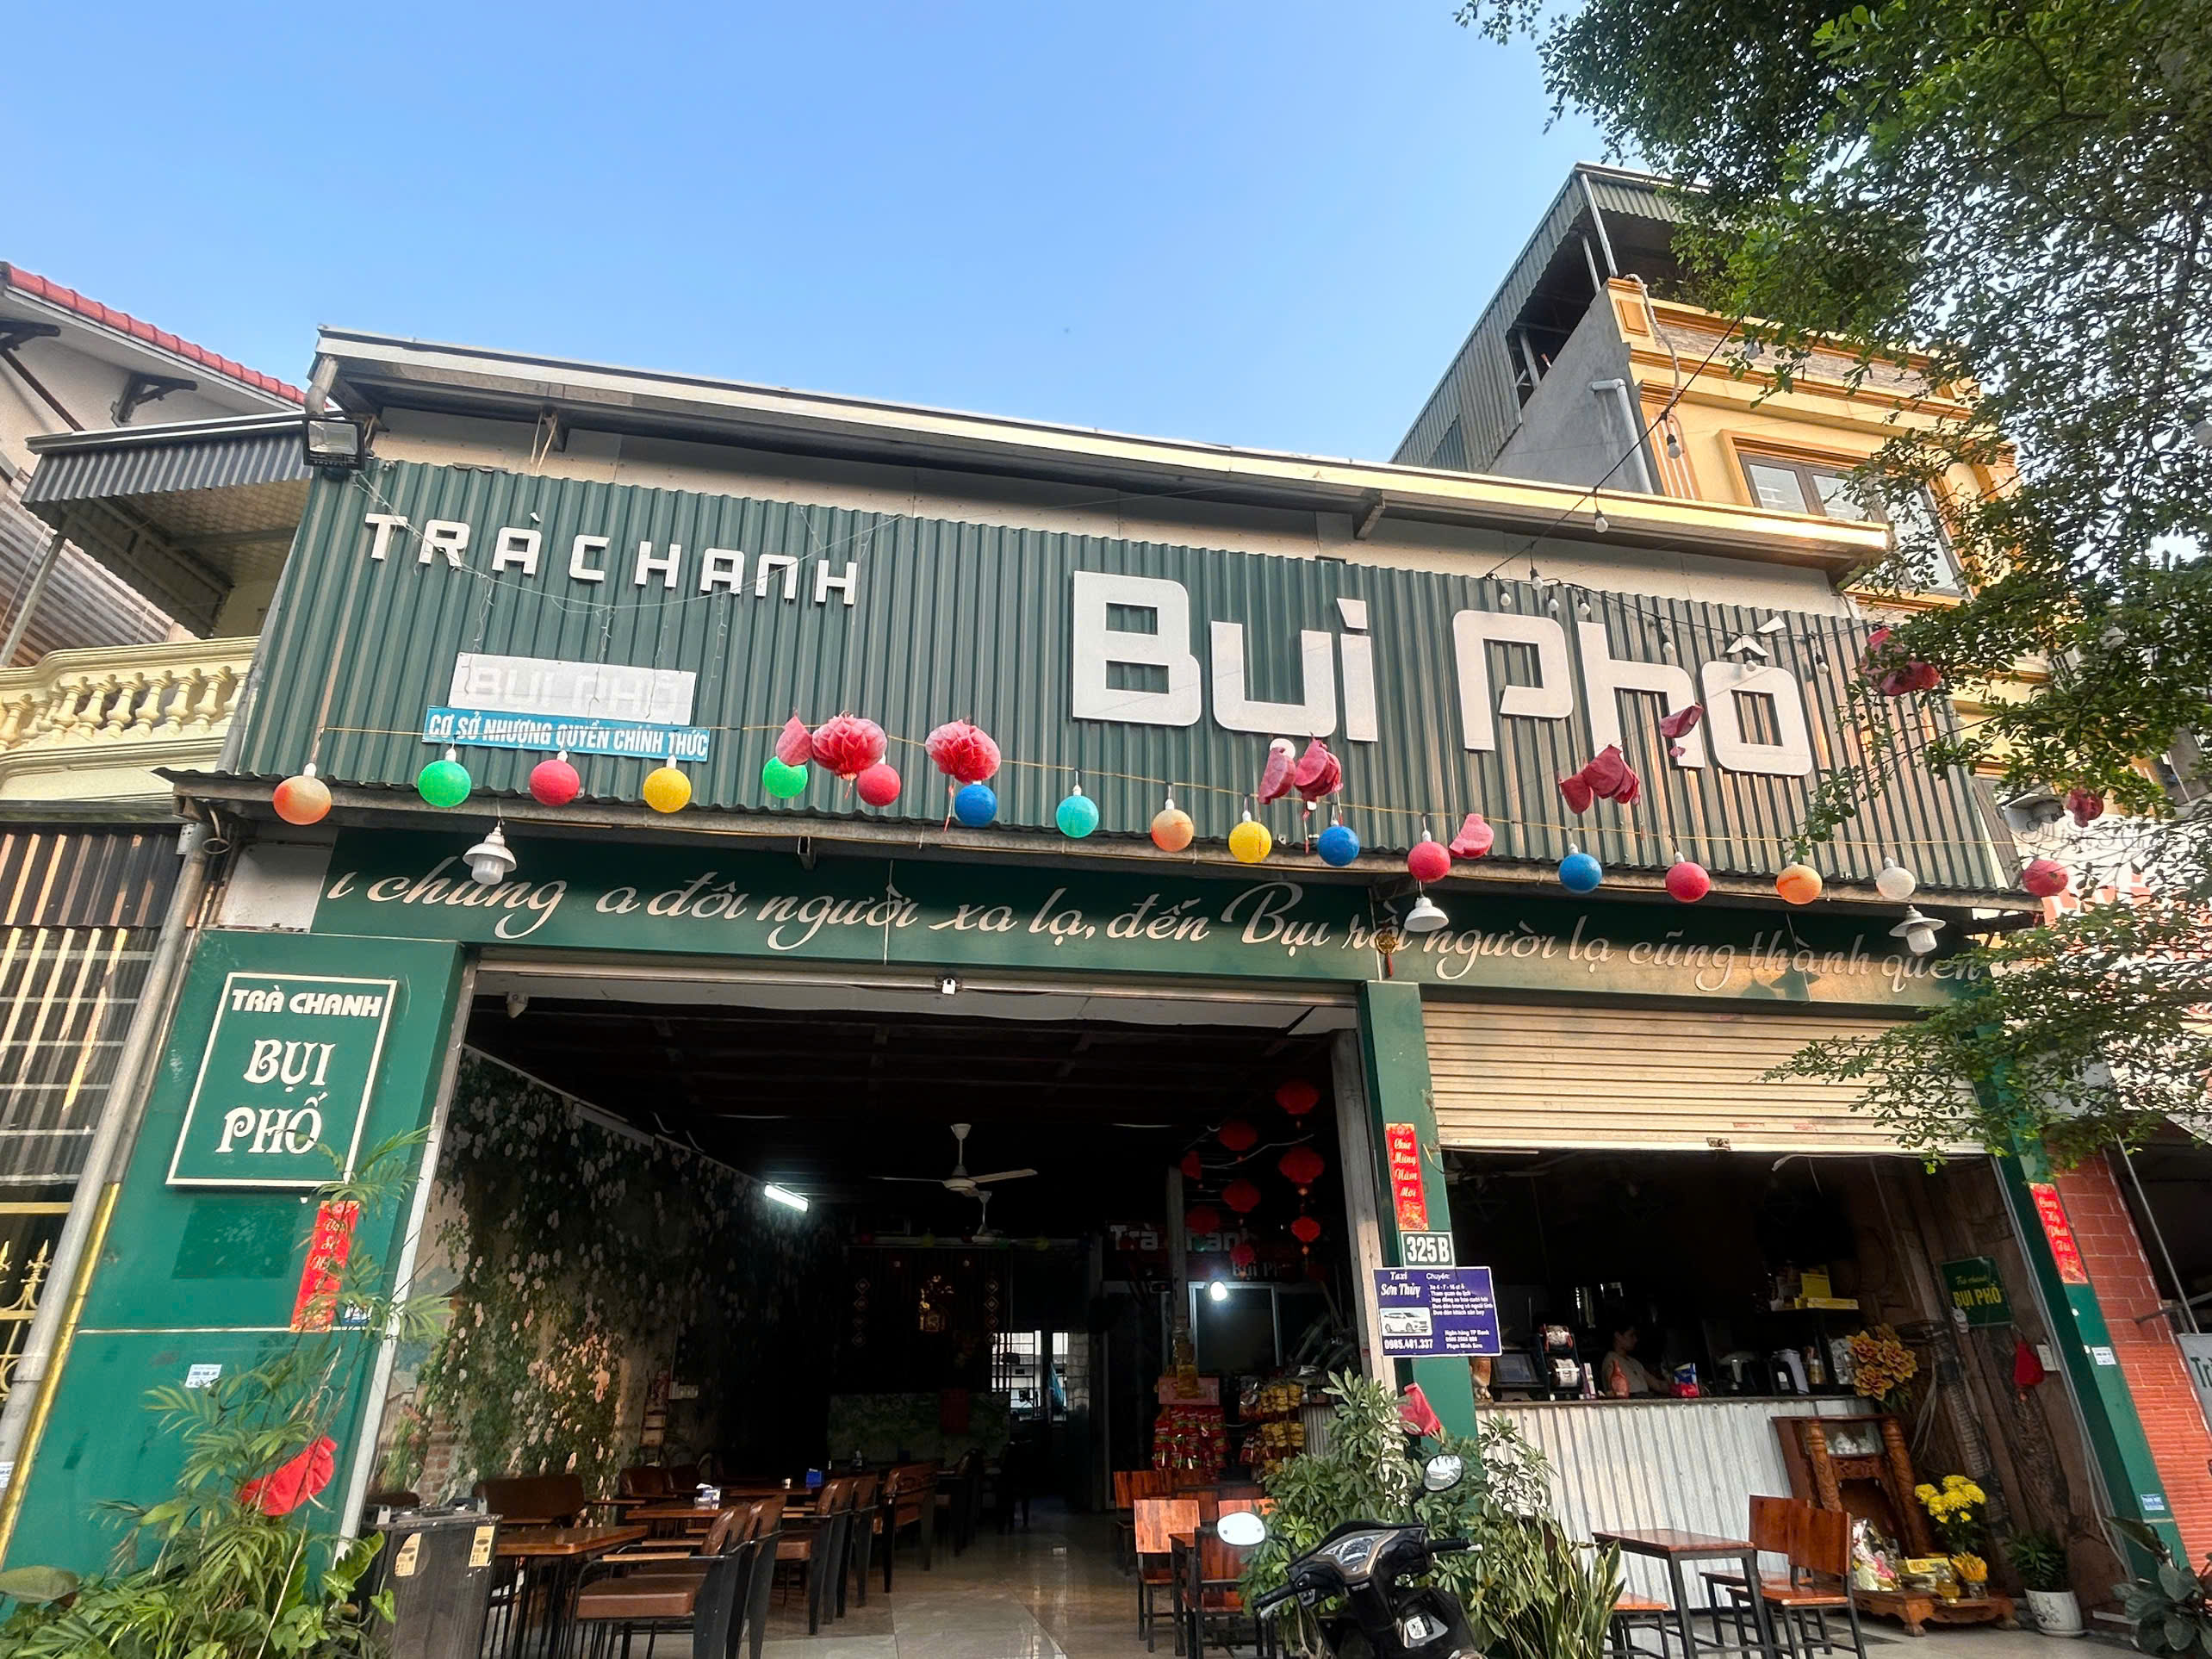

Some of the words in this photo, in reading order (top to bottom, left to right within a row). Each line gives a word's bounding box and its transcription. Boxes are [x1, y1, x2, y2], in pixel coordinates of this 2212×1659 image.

[364, 512, 542, 576] TRÀ
[428, 713, 454, 740] CƠ
[456, 710, 482, 741] SỞ
[483, 718, 552, 749] NHƯỢNG
[556, 718, 609, 752] QUYỀN
[612, 725, 664, 754] CHÍNH
[667, 727, 709, 757] THỨC
[646, 871, 750, 920] đôi
[755, 882, 920, 951] người
[928, 902, 1018, 933] xa
[1028, 886, 1097, 948] lạ,
[1106, 892, 1211, 942] đến
[1220, 880, 1330, 957] Bụi
[1422, 920, 1559, 981] người
[1567, 914, 1617, 975] lạ
[1627, 929, 1738, 992] cũng
[1748, 929, 1874, 978] thành
[231, 985, 285, 1013] TRÀ
[289, 992, 383, 1017] CHANH
[243, 1039, 337, 1093] BỤI
[214, 1091, 329, 1155] PHỐ
[1389, 1271, 1408, 1282] Taxi
